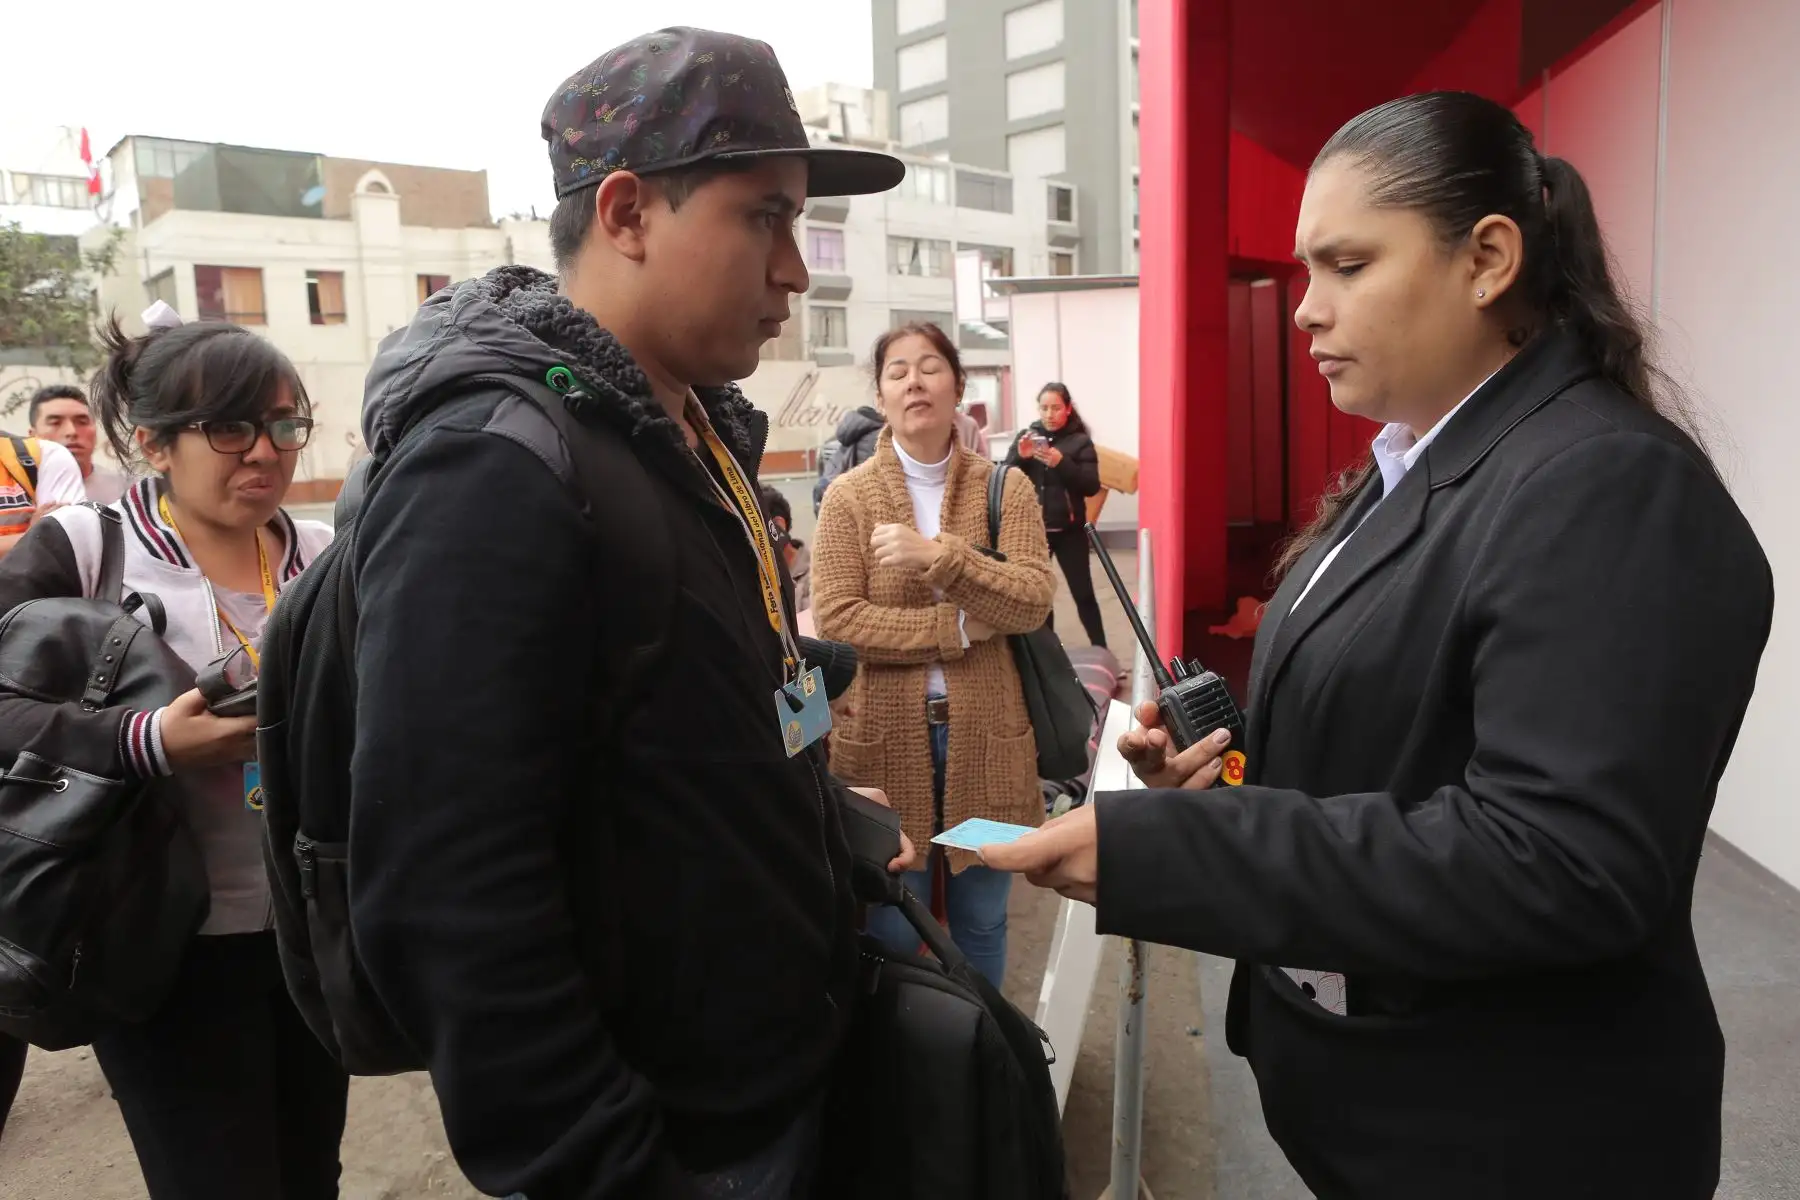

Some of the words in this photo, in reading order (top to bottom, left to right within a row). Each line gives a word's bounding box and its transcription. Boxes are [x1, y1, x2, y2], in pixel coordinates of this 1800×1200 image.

[727, 466, 738, 485] Lima
[736, 485, 744, 495] de
[742, 495, 755, 515] Libro
[751, 516, 760, 528] del
[768, 591, 779, 614] Feria
[1225, 757, 1244, 780] 8
